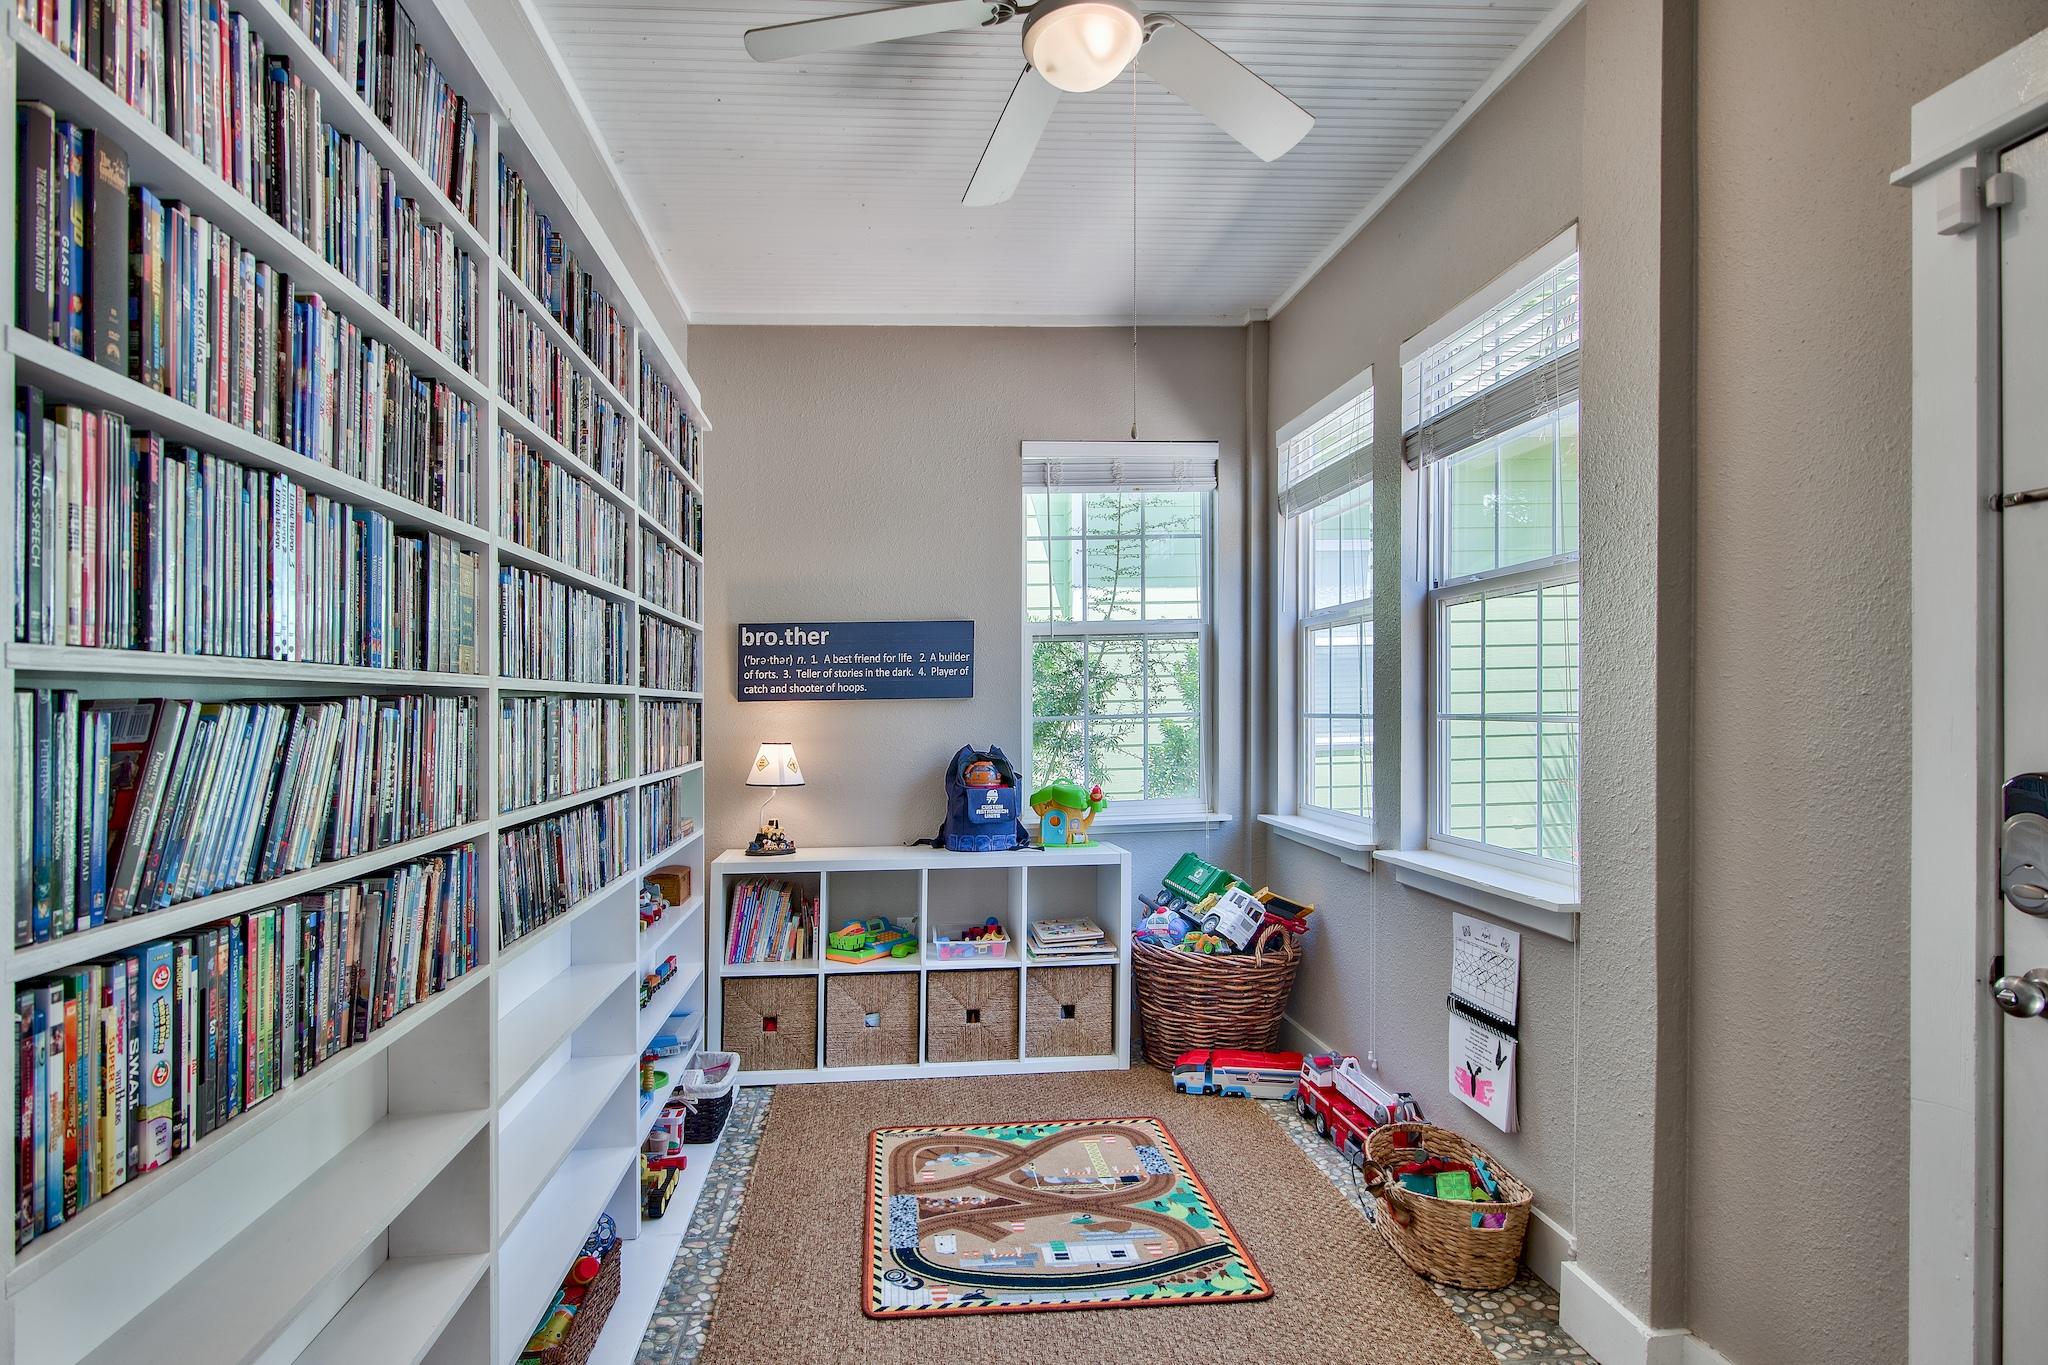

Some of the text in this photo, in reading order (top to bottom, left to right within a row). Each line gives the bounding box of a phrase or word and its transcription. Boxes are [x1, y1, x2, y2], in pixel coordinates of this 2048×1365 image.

[36, 184, 47, 207] GIRL
[35, 216, 47, 257] DRAGON
[35, 256, 47, 293] TATTOO
[61, 236, 70, 286] GLASS
[30, 458, 42, 568] KING'S SPEECH
[741, 626, 830, 646] bro.ther
[743, 665, 970, 680] of forts. 3. Teller of stories in the dark. 4. Player of
[796, 655, 807, 665] n.
[823, 654, 831, 664] A
[832, 653, 853, 664] best
[854, 653, 881, 663] friend
[882, 653, 897, 663] for
[929, 652, 937, 662] A
[938, 651, 970, 662] builder
[743, 682, 868, 694] catch and shooter of hoops.
[148, 751, 166, 786] PIRATES
[261, 790, 274, 827] The Post
[54, 826, 63, 860] DRAGON
[158, 1000, 166, 1025] MARIO
[209, 1019, 216, 1034] to
[116, 1015, 125, 1056] Super
[128, 1037, 140, 1112] S.W.A.T.
[108, 1087, 115, 1096] 8
[66, 1127, 76, 1138] 2
